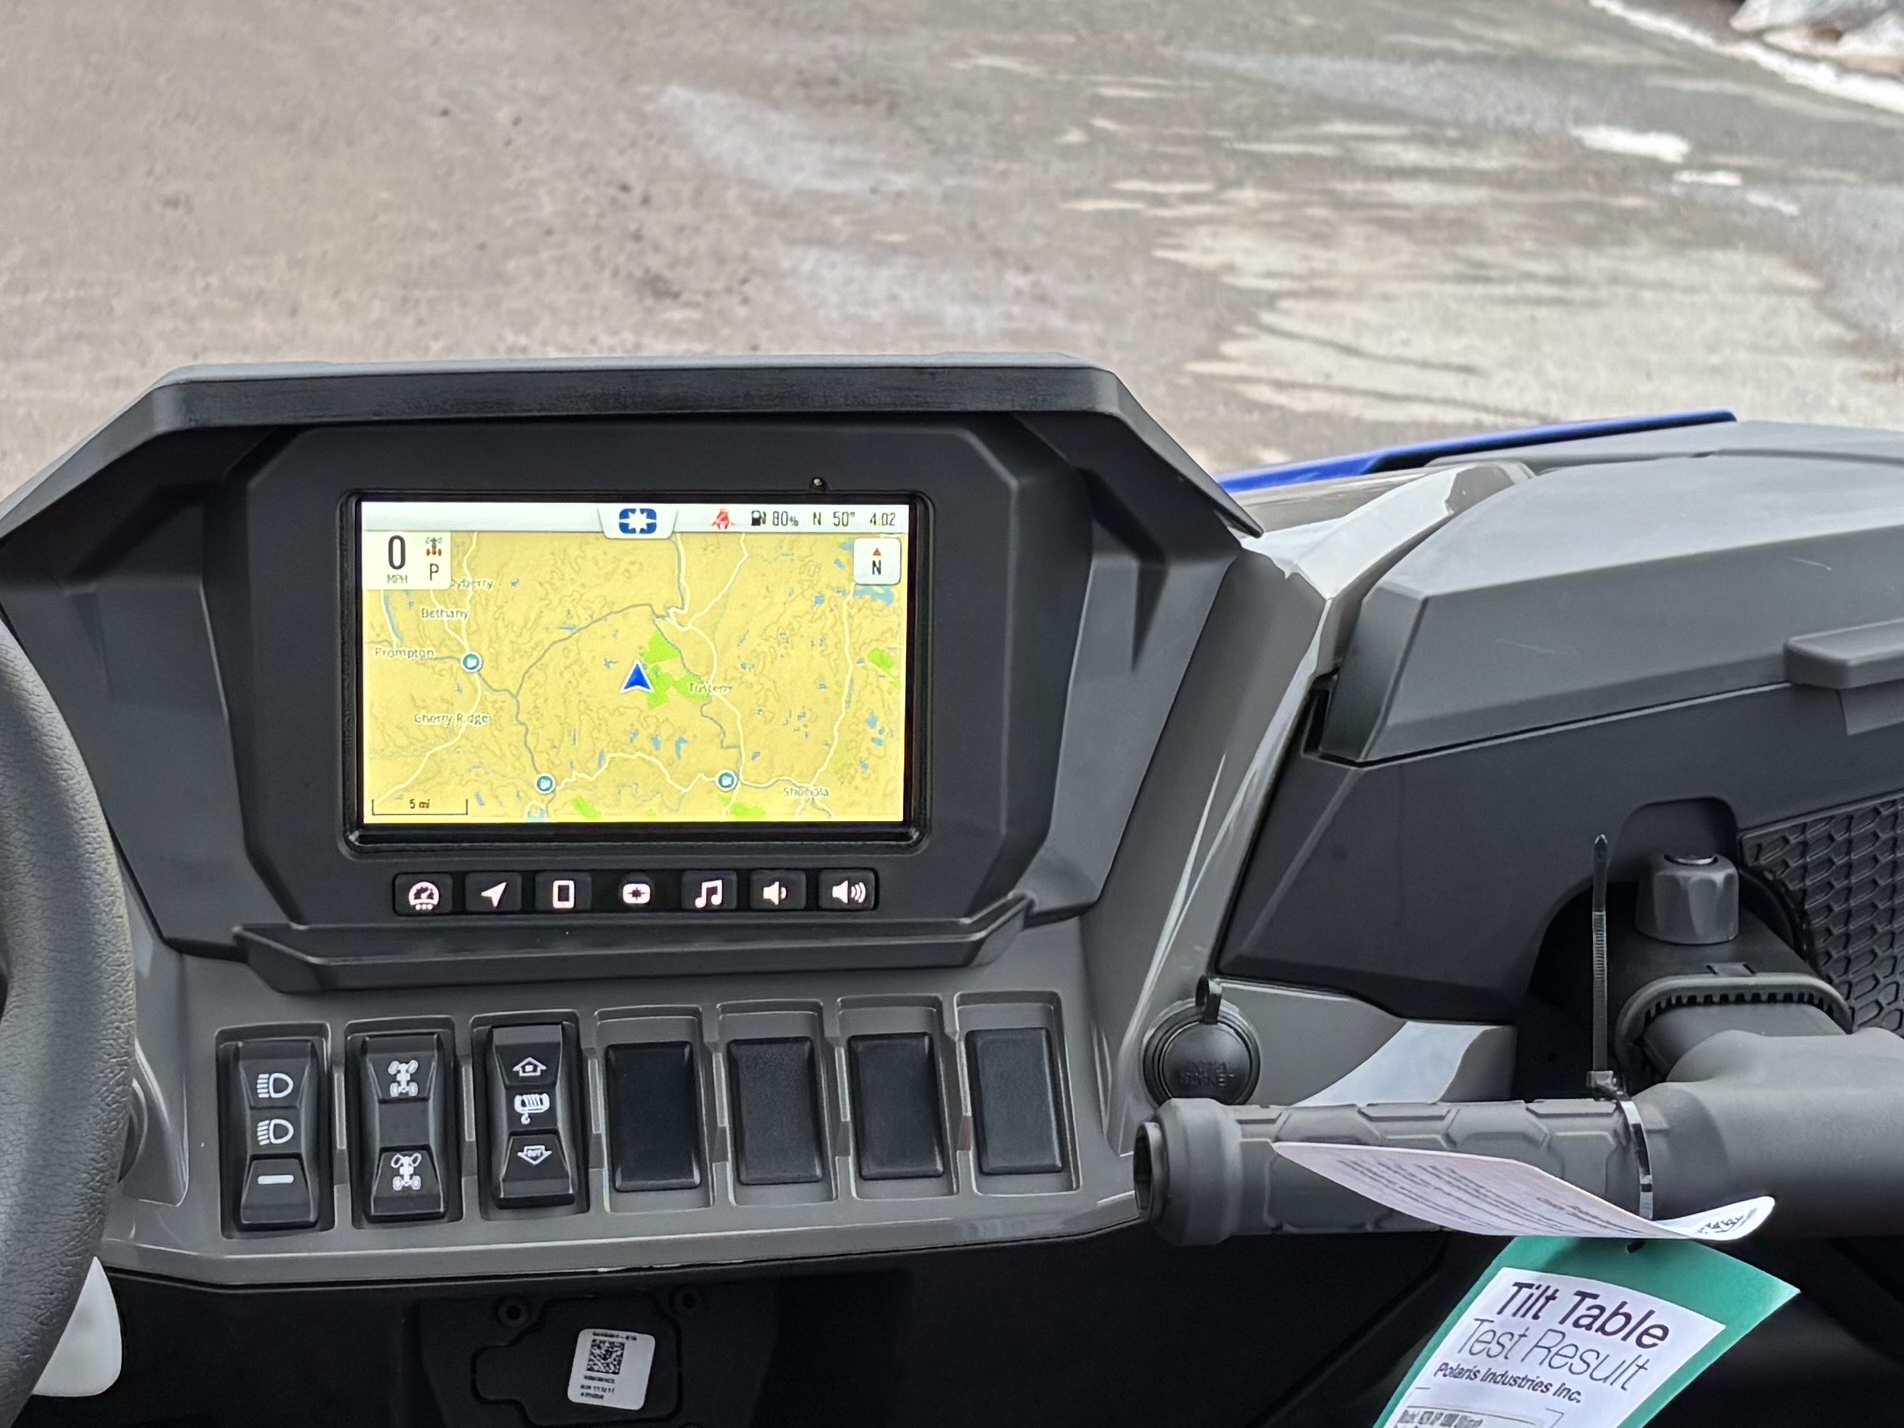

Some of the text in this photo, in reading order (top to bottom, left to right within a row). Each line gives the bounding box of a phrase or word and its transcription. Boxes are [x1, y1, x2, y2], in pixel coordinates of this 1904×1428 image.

[387, 534, 406, 570] 0
[429, 563, 439, 581] P
[871, 560, 882, 575] N
[386, 574, 408, 584] MPH
[421, 607, 469, 619] Bethany
[375, 648, 434, 659] Prompton
[456, 713, 489, 725] Rdge
[409, 798, 416, 810] 5
[1496, 1281, 1670, 1350] Tilt Table
[1457, 1317, 1651, 1391] Test Result
[1433, 1362, 1582, 1403] Polaris Industries Inc.
